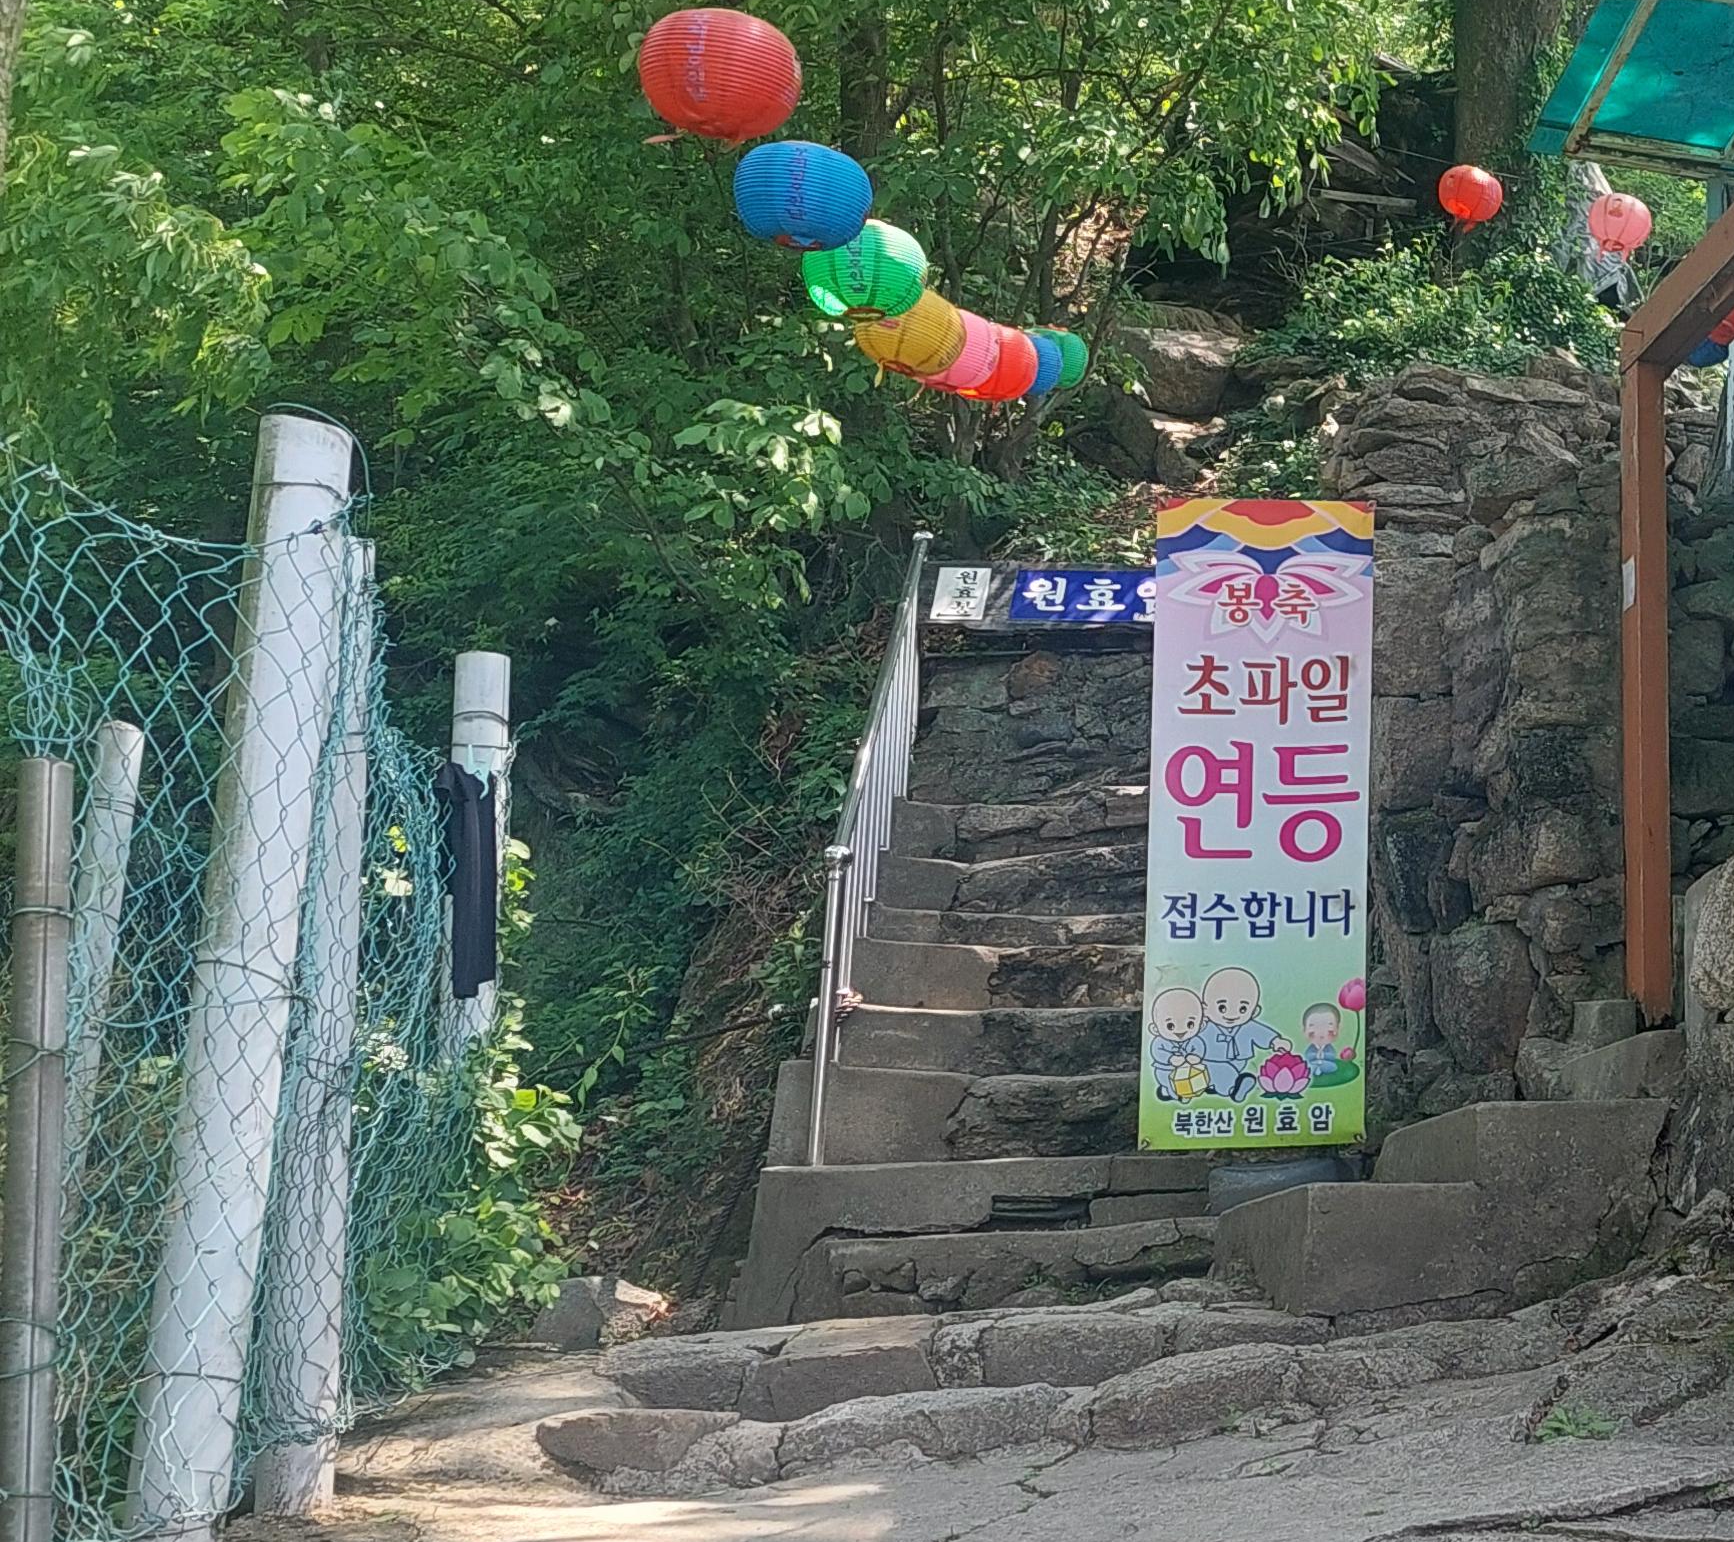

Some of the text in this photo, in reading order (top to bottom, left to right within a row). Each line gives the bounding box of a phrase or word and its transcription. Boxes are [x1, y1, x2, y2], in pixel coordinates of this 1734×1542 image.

[1178, 654, 1349, 726] 초파일
[1165, 740, 1360, 862] 연등
[1160, 889, 1356, 939] 접수합니다
[1174, 1111, 1234, 1136] 북한산
